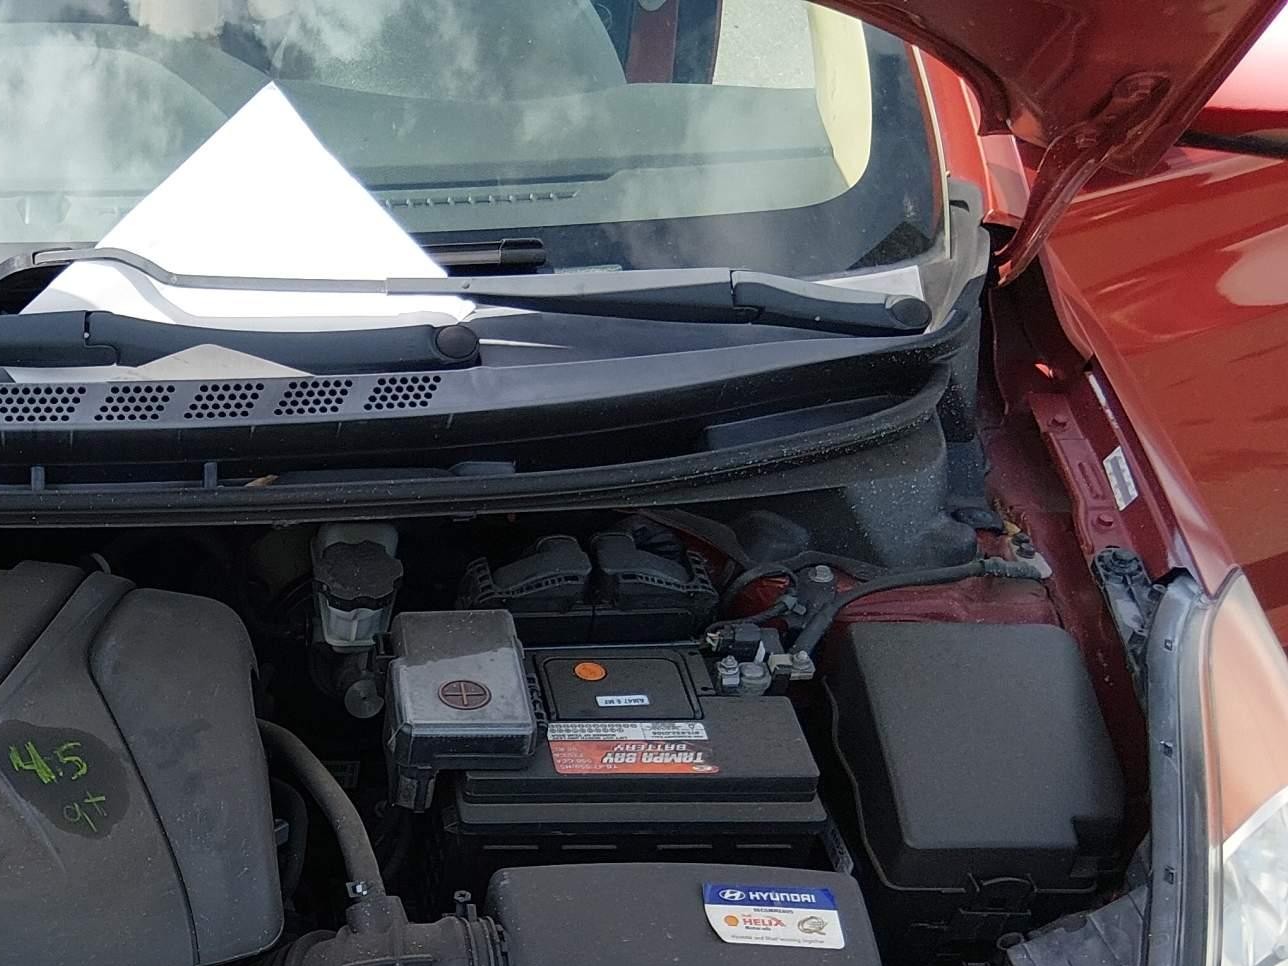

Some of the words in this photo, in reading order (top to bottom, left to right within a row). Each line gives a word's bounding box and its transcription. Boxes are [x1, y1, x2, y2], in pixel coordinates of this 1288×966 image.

[614, 743, 687, 752] BATTERY
[602, 751, 637, 764] BAY
[641, 751, 704, 763] TAMPA
[748, 891, 816, 903] HYUNDAI
[742, 916, 786, 927] HELIX
